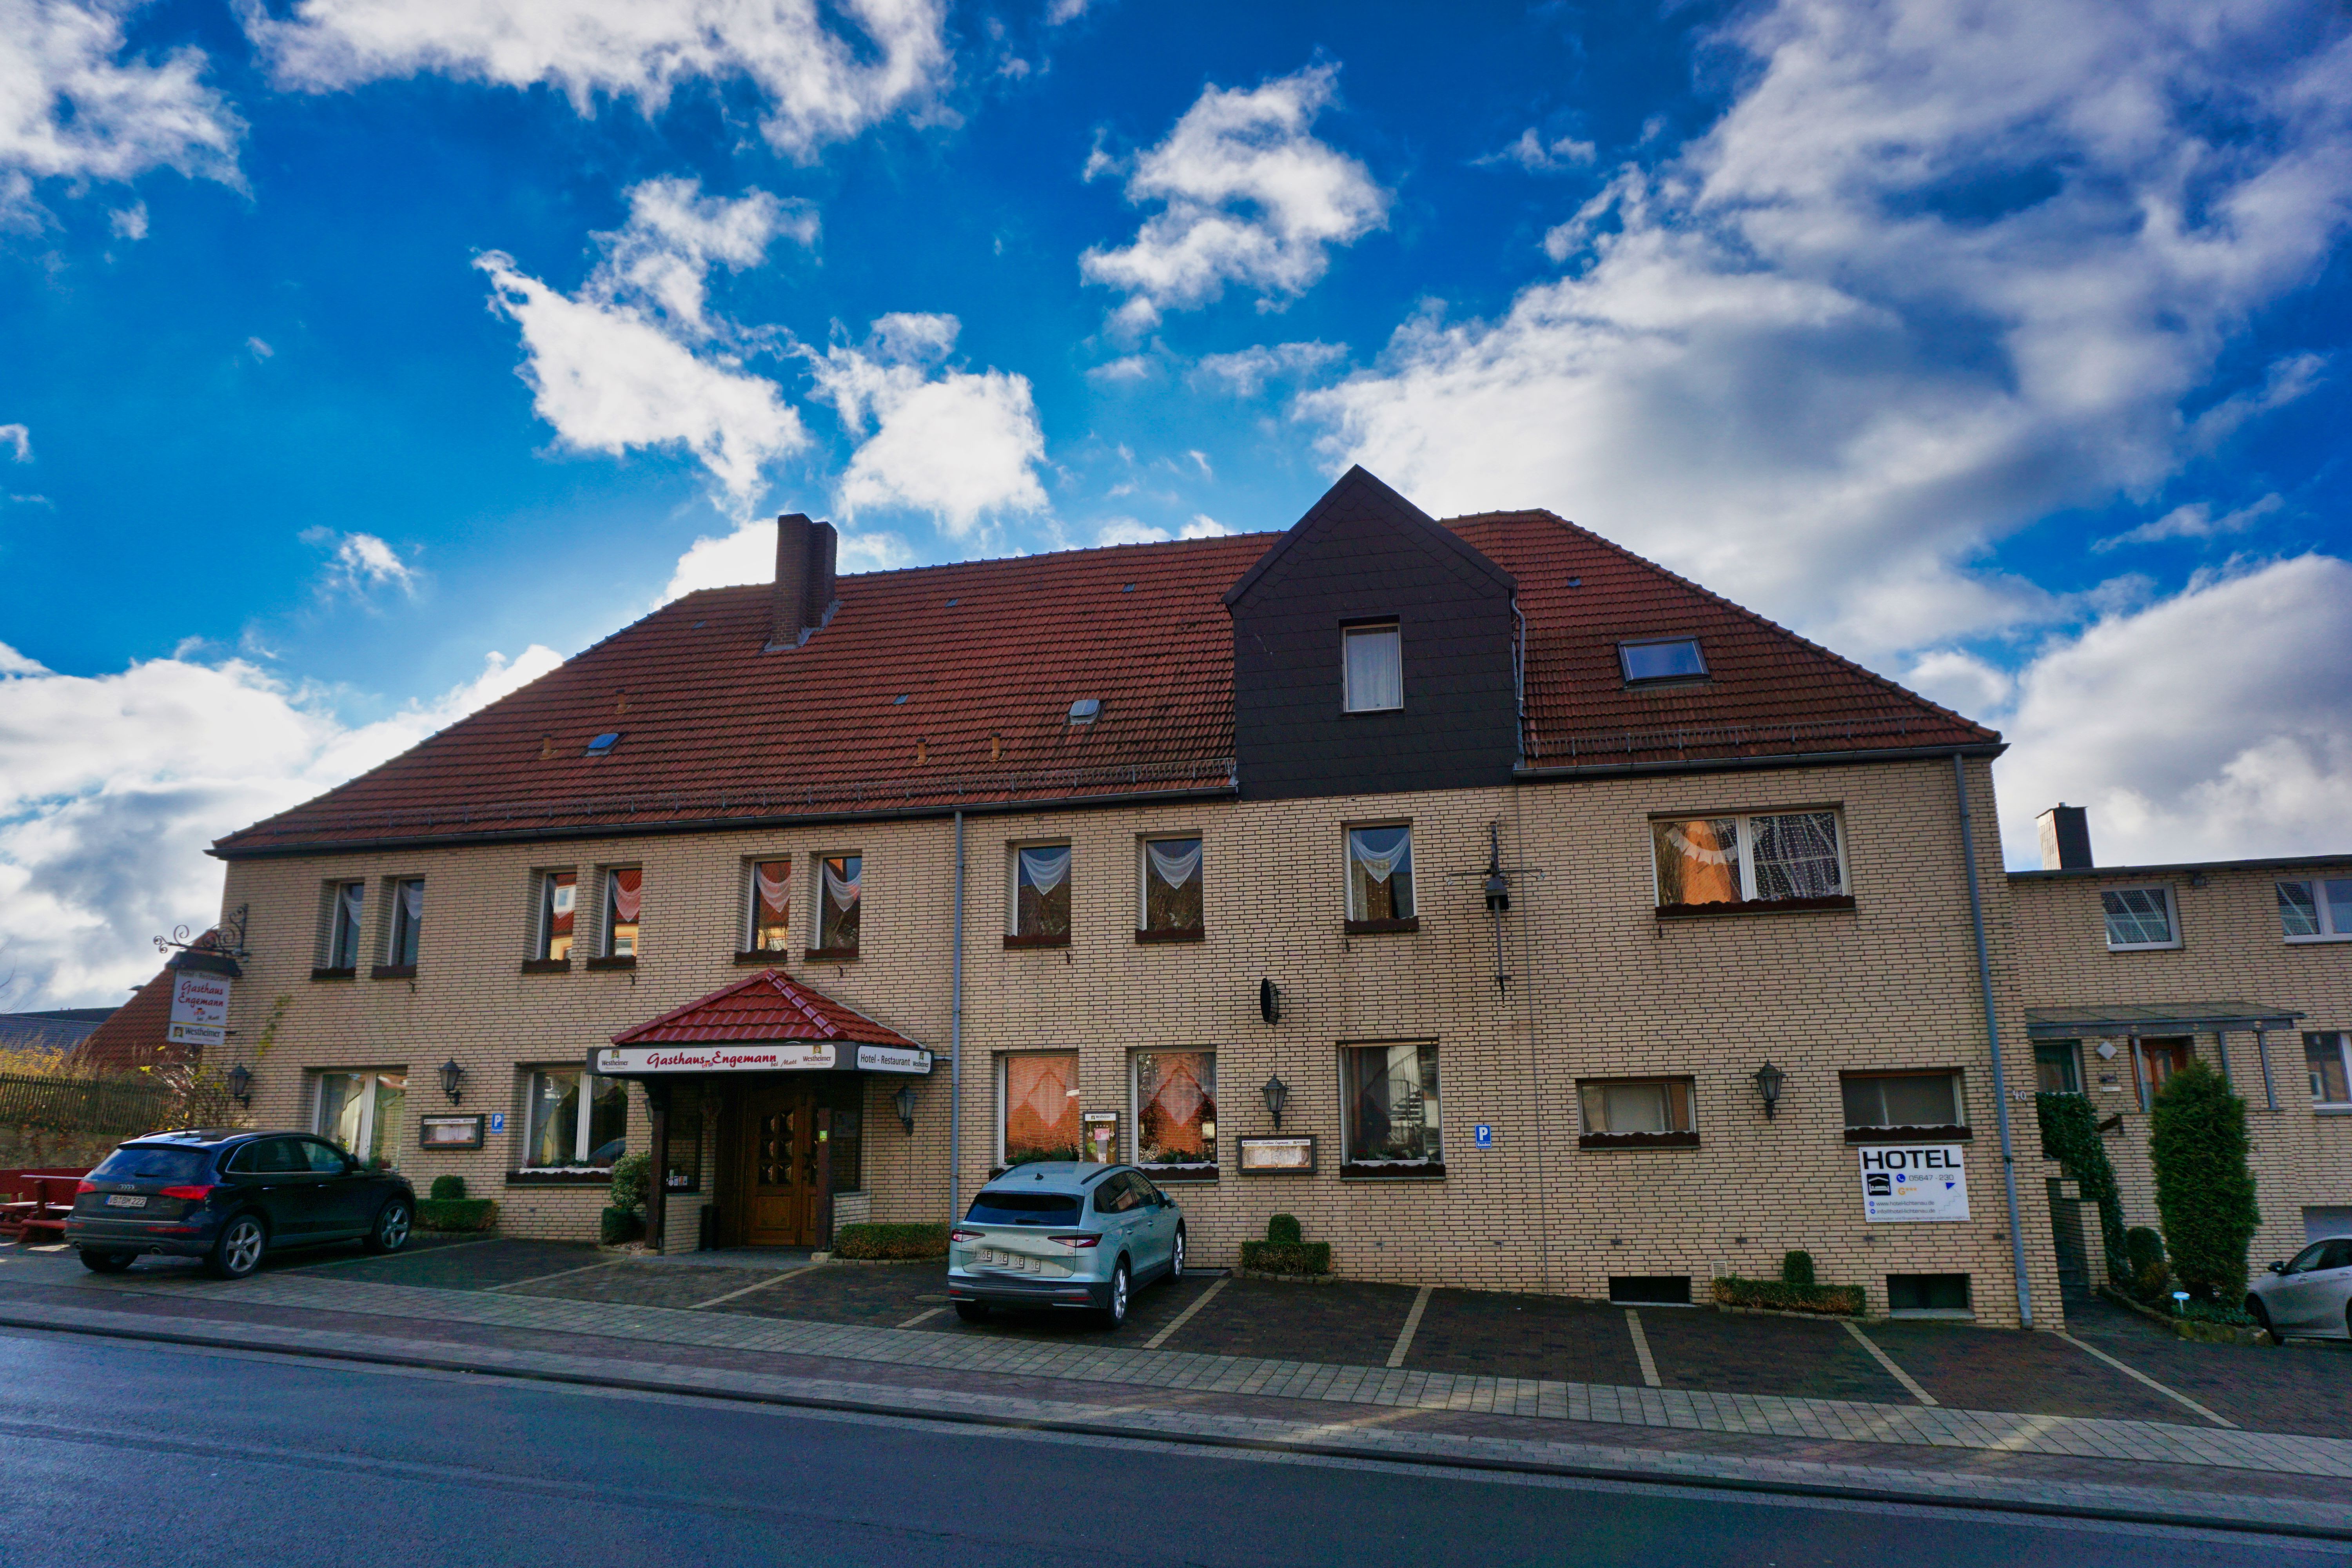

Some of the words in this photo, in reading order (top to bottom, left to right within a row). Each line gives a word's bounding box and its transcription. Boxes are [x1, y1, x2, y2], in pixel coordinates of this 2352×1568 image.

[181, 981, 223, 995] Gasthaus
[178, 992, 223, 1008] Engemann
[185, 1027, 221, 1037] Westheimer
[647, 1052, 704, 1069] Gasthaus
[712, 1051, 777, 1068] Engemann
[780, 1059, 797, 1067] Matt
[860, 1053, 876, 1063] Hotel
[881, 1055, 910, 1066] Restaurant
[2013, 1090, 2026, 1100] 40
[494, 1115, 501, 1127] P
[1479, 1127, 1488, 1141] P
[1863, 1149, 1961, 1169] HOTEL
